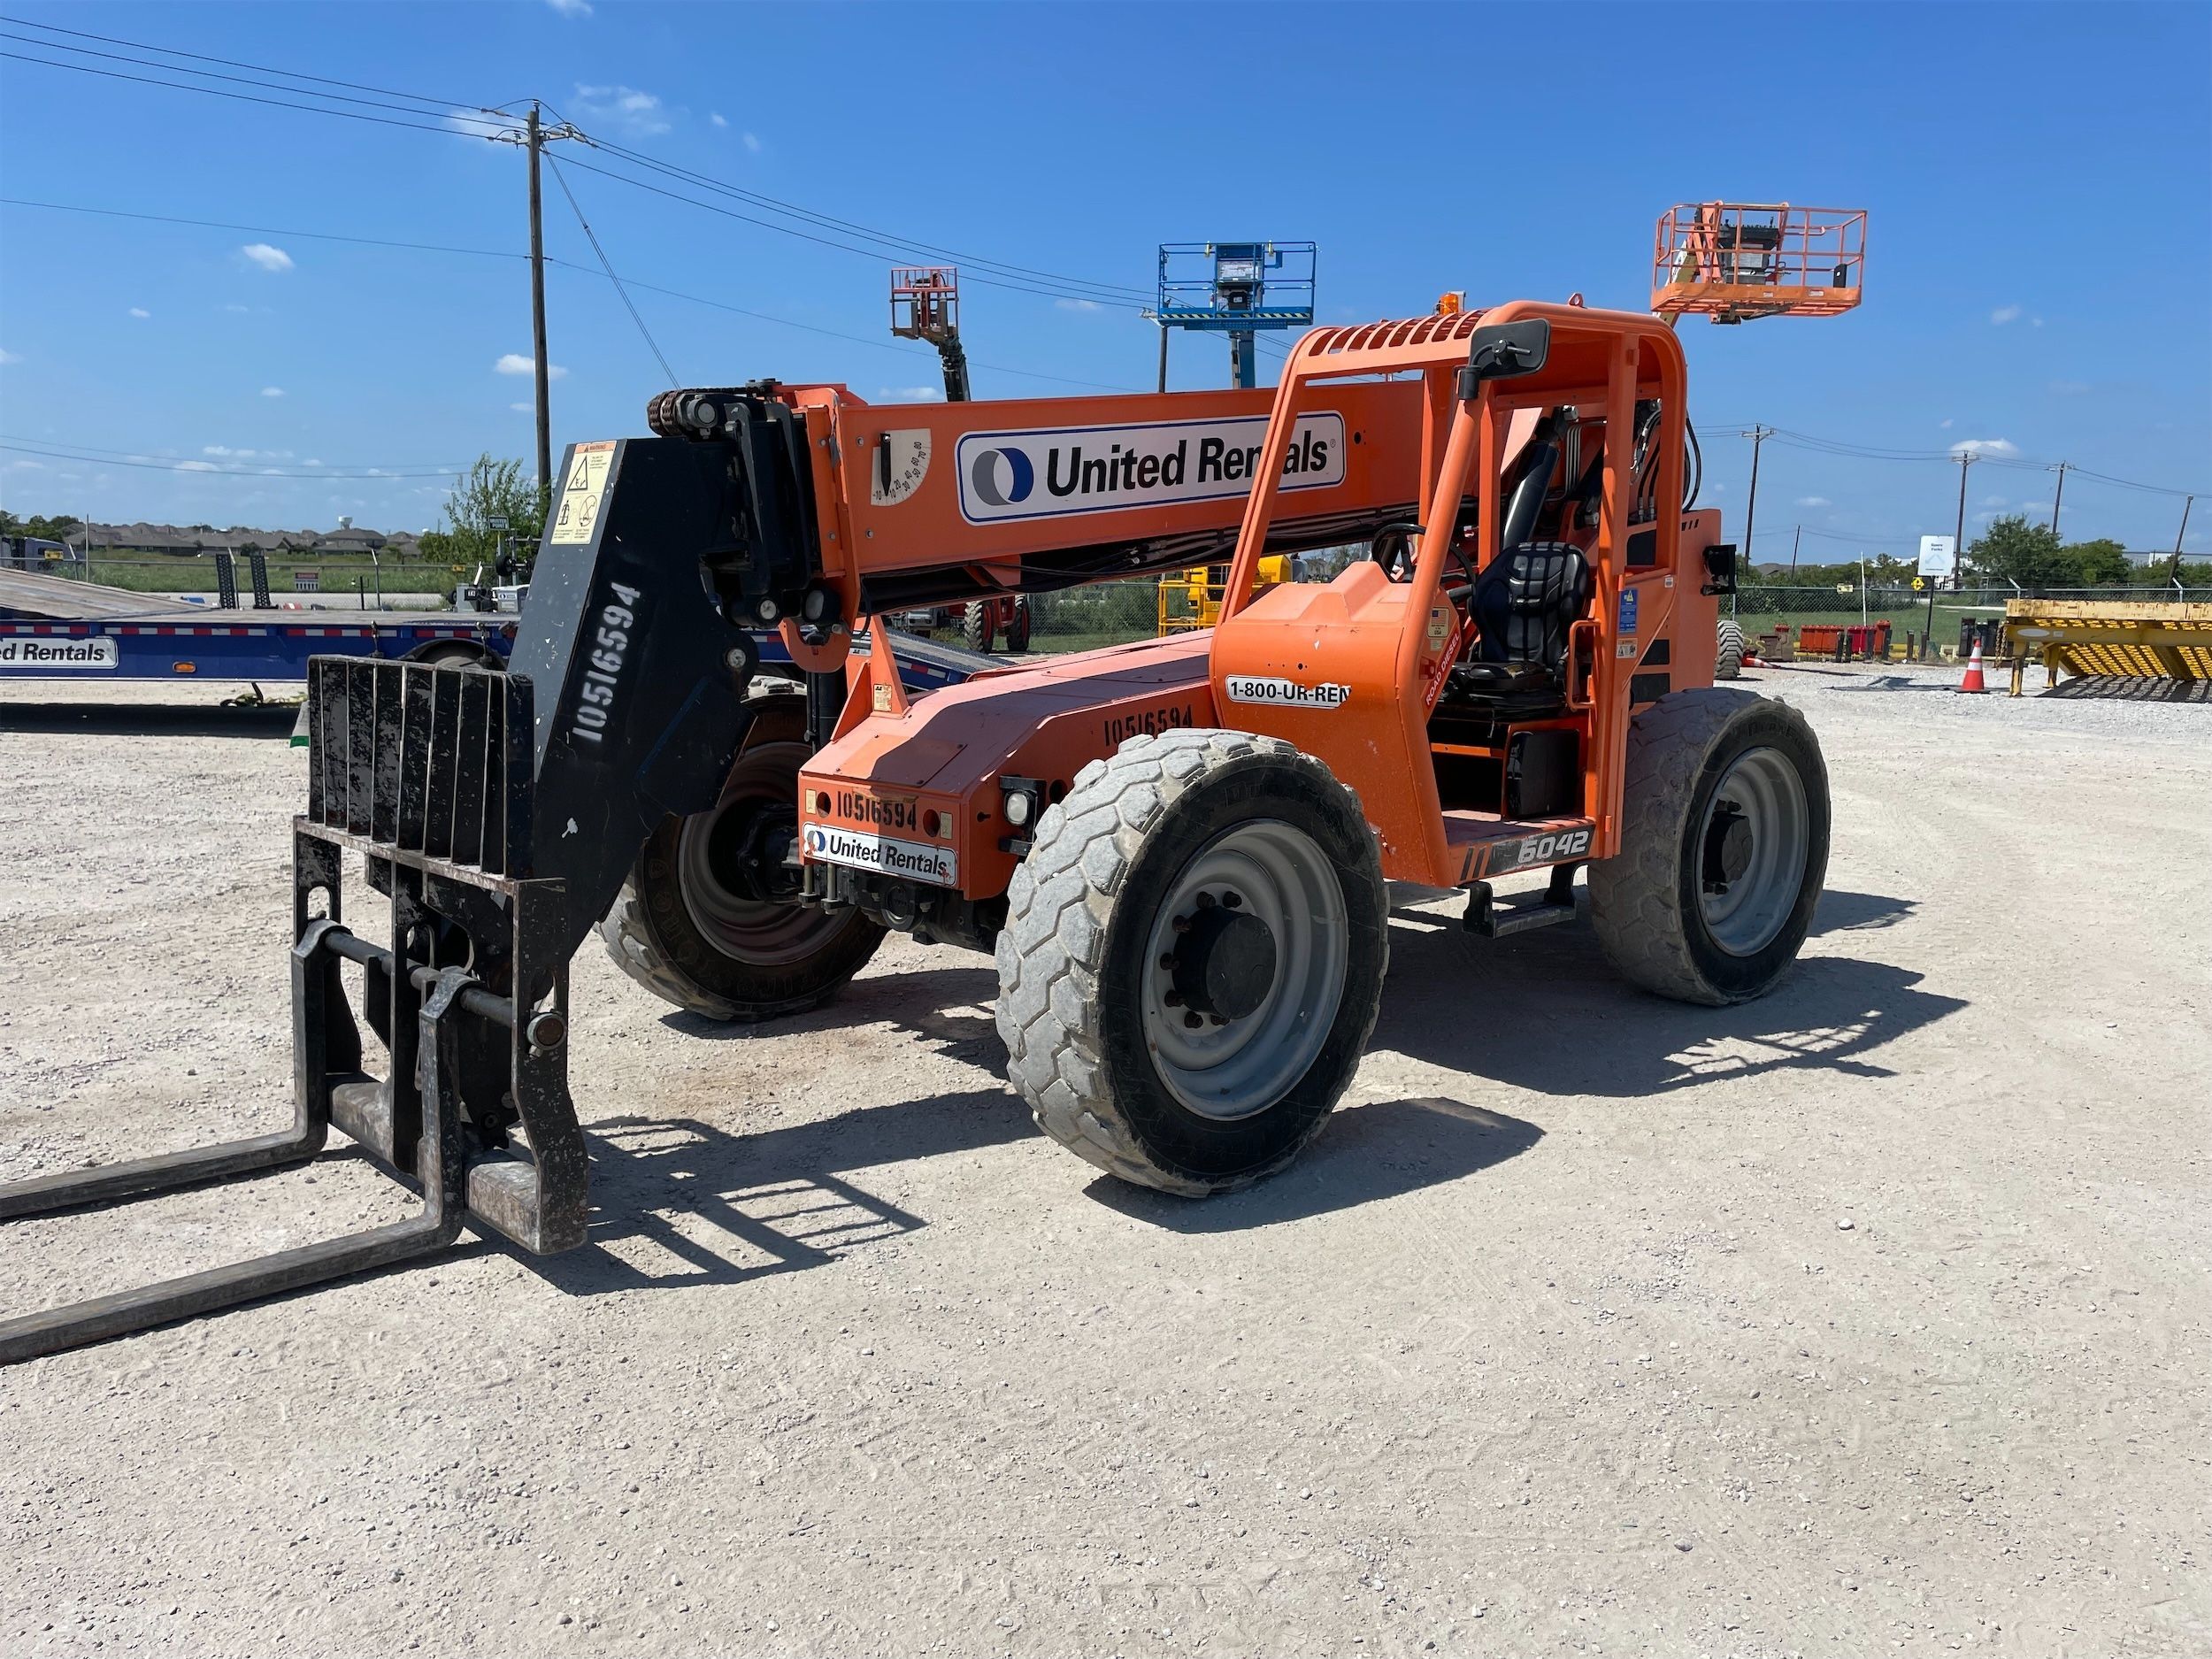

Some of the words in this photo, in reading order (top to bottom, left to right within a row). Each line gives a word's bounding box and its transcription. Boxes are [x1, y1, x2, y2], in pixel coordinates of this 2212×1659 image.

[918, 450, 926, 459] 70
[1046, 439, 1187, 497] United
[1197, 430, 1328, 483] Renals
[894, 479, 902, 490] 20
[902, 480, 910, 492] 30
[911, 468, 921, 478] 50
[889, 488, 896, 498] 10
[23, 642, 105, 661] Rentals
[572, 581, 641, 742] 10516594
[1425, 672, 1442, 705] ROAD
[1440, 633, 1460, 671] DIESEL
[1104, 704, 1193, 747] 10516594
[836, 790, 918, 832] 10516594
[829, 834, 881, 864] United
[885, 845, 948, 876] Rentals
[1517, 830, 1589, 864] 6042
